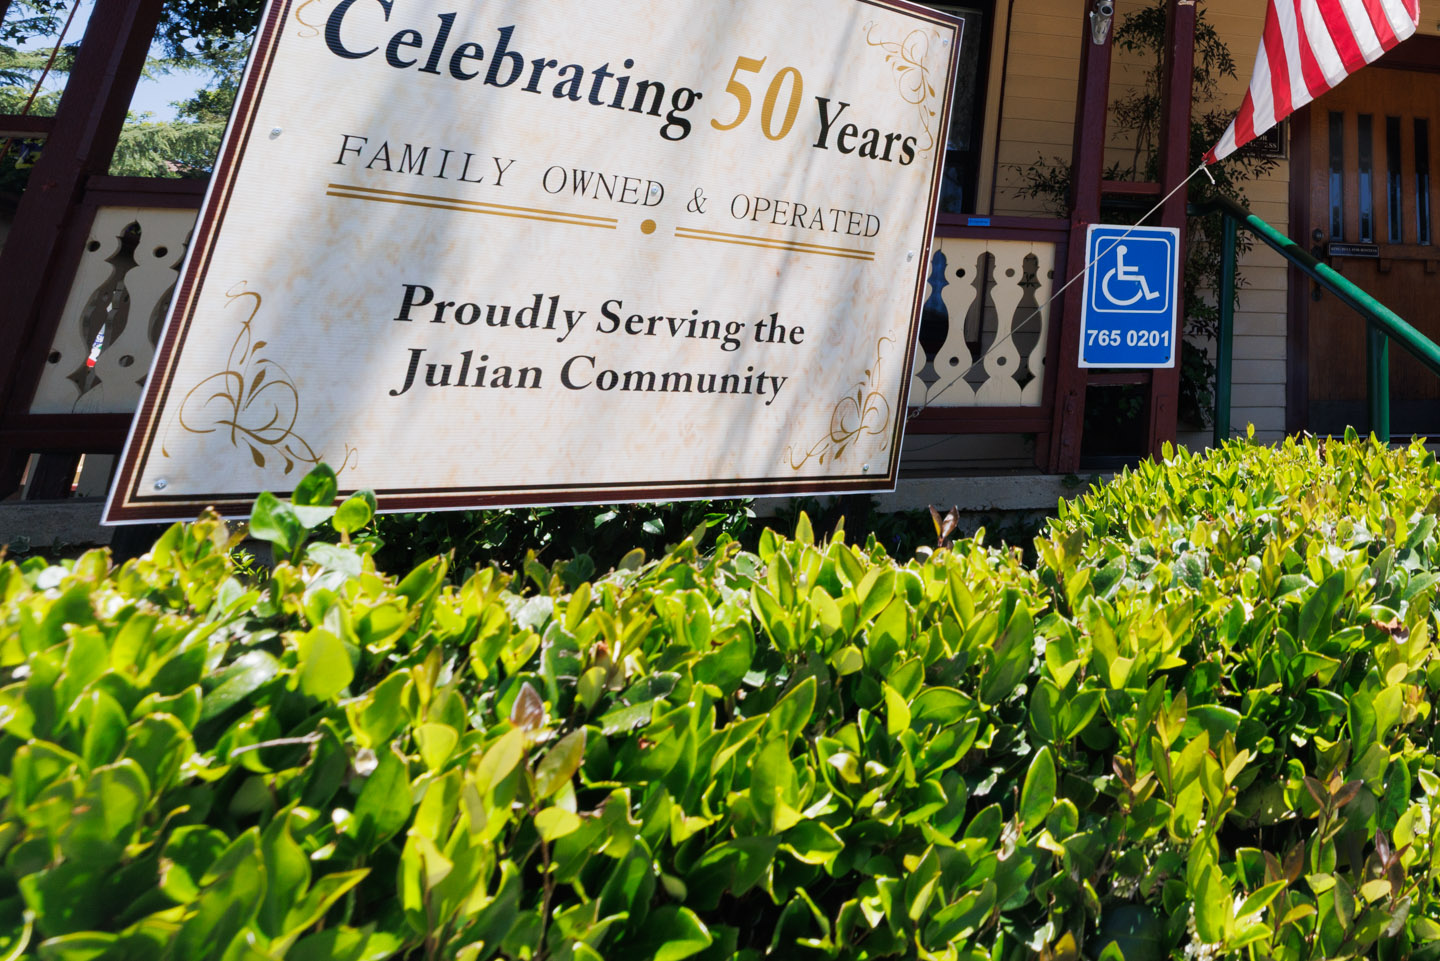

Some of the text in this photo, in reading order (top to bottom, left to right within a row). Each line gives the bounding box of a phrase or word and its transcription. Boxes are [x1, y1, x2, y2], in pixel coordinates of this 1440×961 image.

[710, 55, 803, 141] 50
[813, 96, 917, 165] Years
[332, 134, 880, 238] FAMILY OWNED & OPERATED
[393, 283, 805, 352] Proudly Serving the
[1087, 329, 1169, 346] 765 0201
[389, 348, 788, 405] Julian Community
